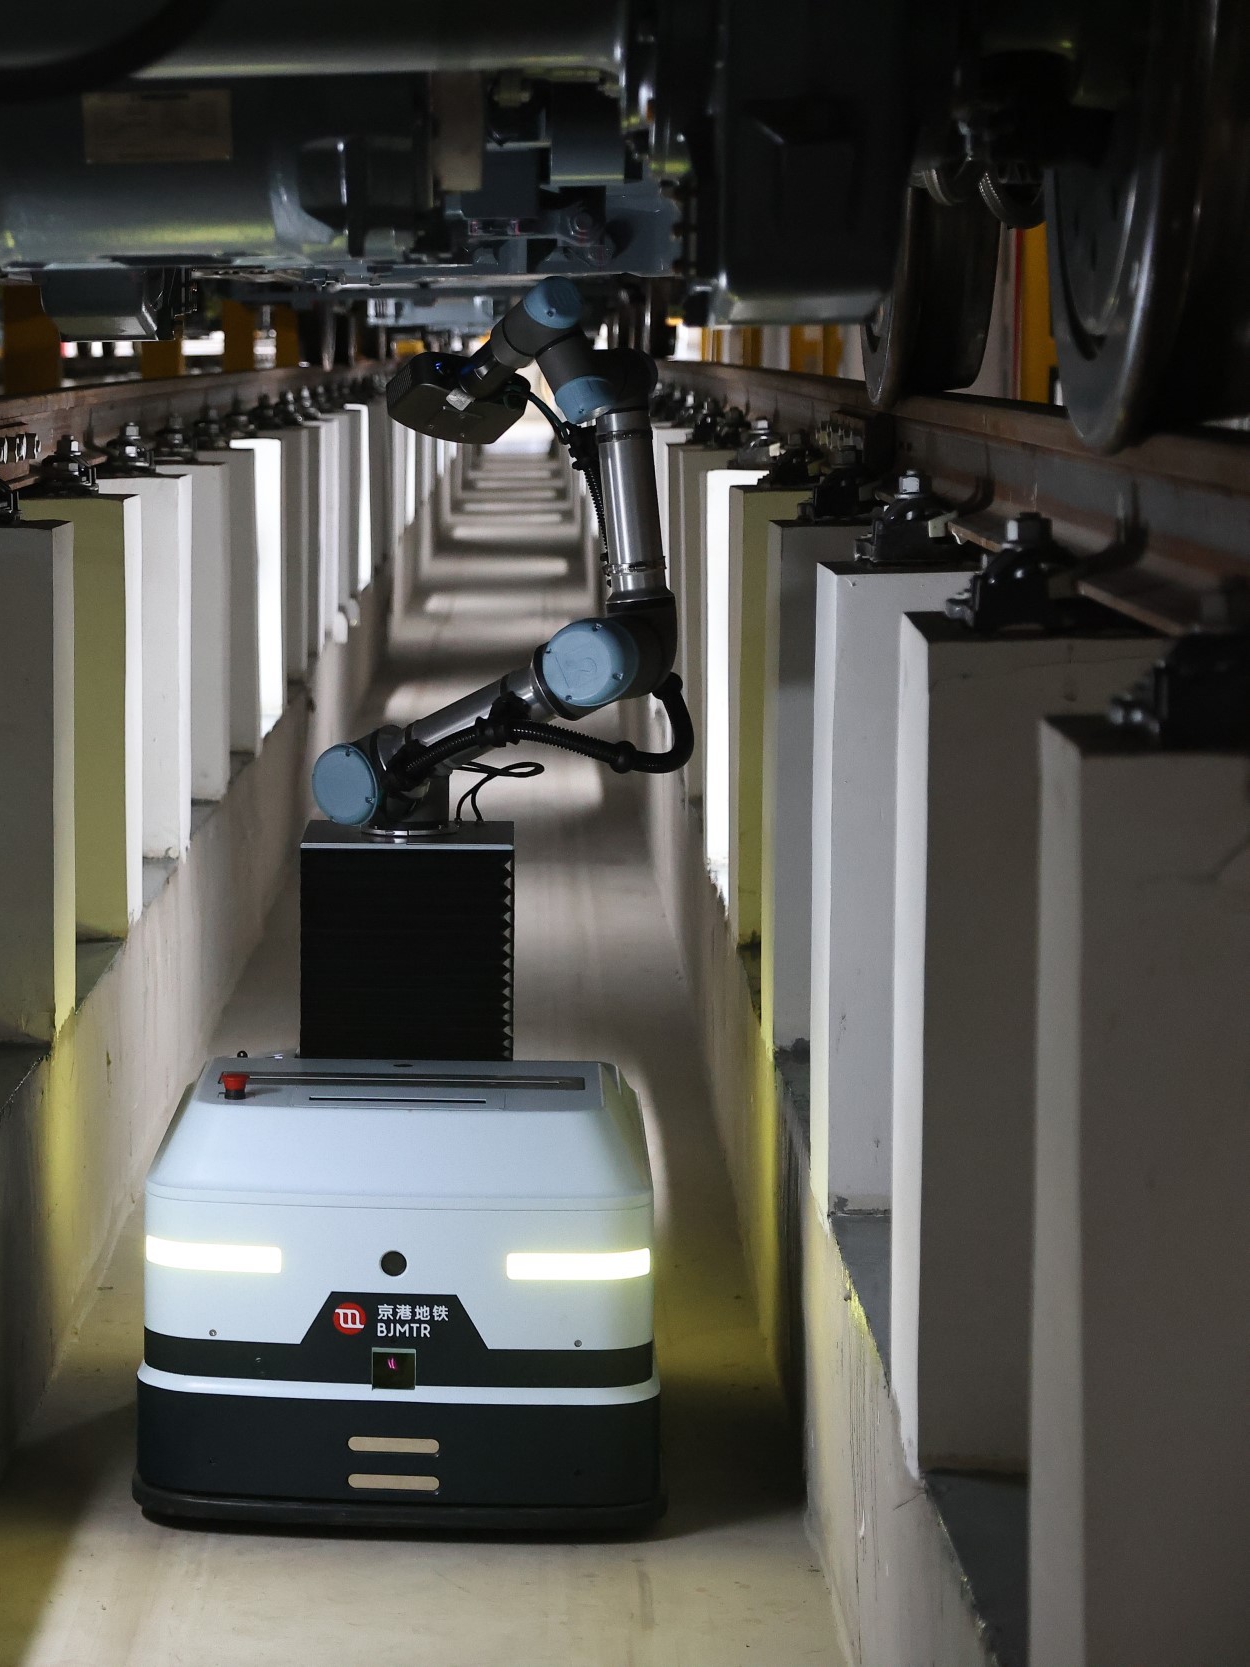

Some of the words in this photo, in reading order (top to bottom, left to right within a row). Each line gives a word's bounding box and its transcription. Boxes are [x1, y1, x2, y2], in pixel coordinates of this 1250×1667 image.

[377, 1304, 449, 1321] 京港地铁
[377, 1323, 431, 1338] BJMTR
